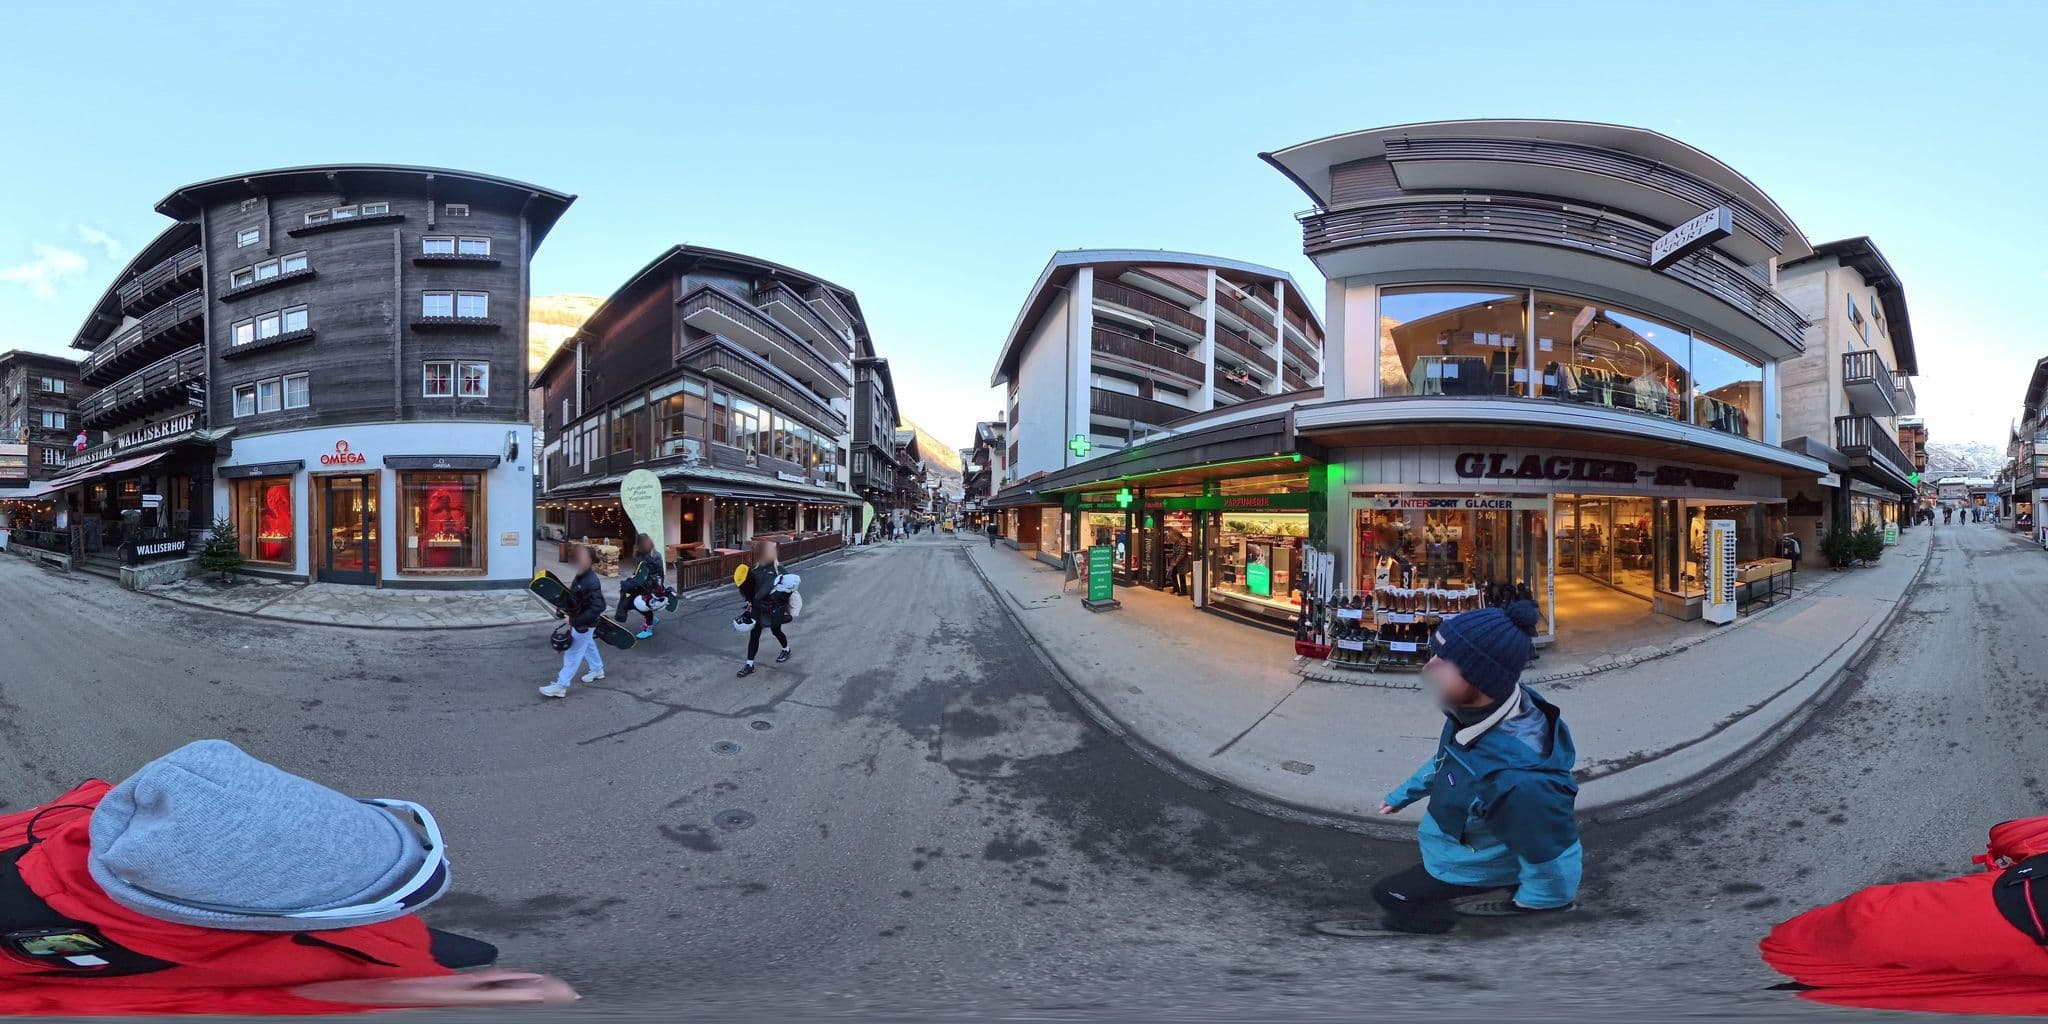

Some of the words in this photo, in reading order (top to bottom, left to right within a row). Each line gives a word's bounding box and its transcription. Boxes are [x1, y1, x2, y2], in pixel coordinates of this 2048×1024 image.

[1655, 213, 1715, 250] GLACIER
[1663, 225, 1706, 252] SPORT
[117, 414, 196, 448] WALLISERHOF
[320, 453, 366, 465] OMEGA
[1401, 499, 1460, 508] INTERSPORT
[1465, 499, 1513, 508] GLACIER
[136, 541, 186, 556] WALLISERHOF
